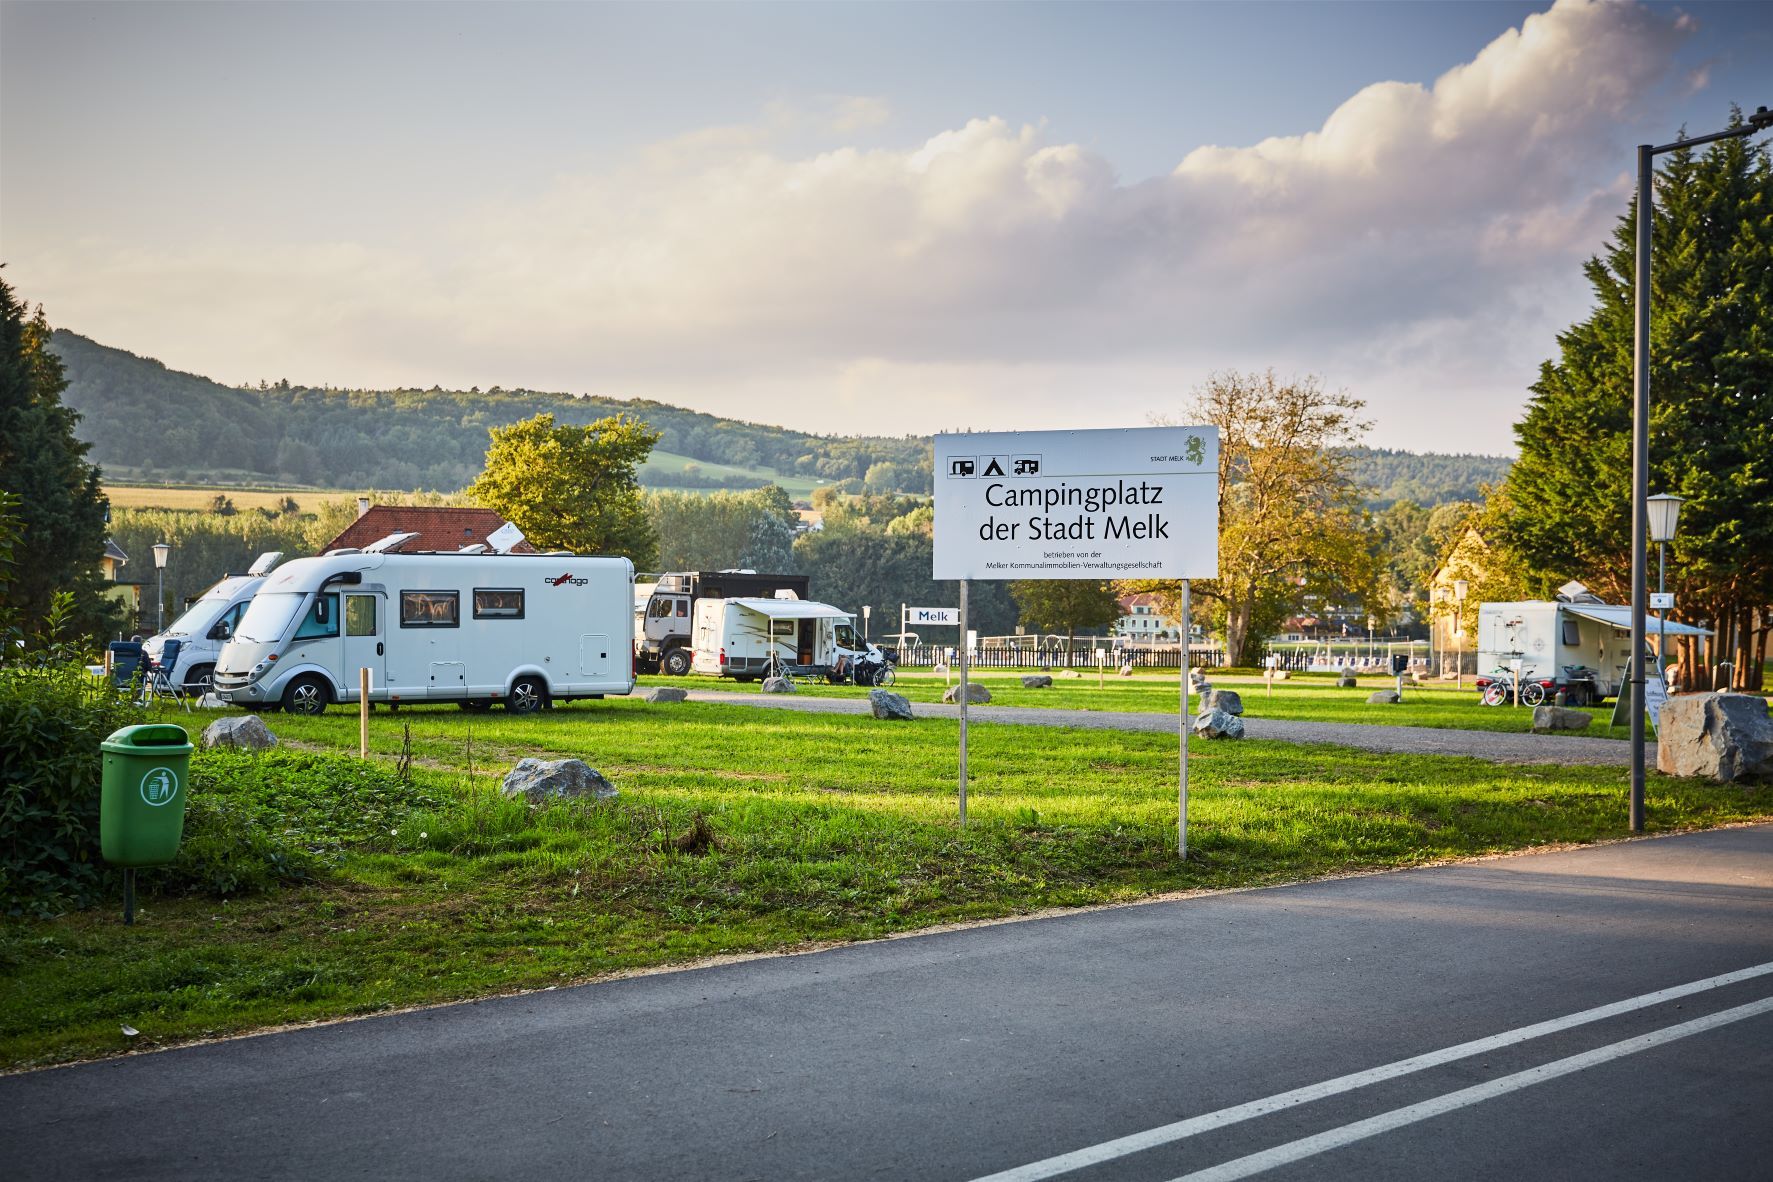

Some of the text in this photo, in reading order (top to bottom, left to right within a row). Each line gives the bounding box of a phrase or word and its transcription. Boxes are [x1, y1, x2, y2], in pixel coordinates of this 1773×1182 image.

[985, 479, 1164, 514] Campingplatz
[979, 513, 1169, 541] der Stadt Melk
[1043, 549, 1102, 559] betrieben von der
[985, 560, 1163, 571] Melker Kommunalimmobilien-Verwaltungsgesellschaft
[544, 572, 589, 587] cahago
[918, 610, 948, 621] Melk
